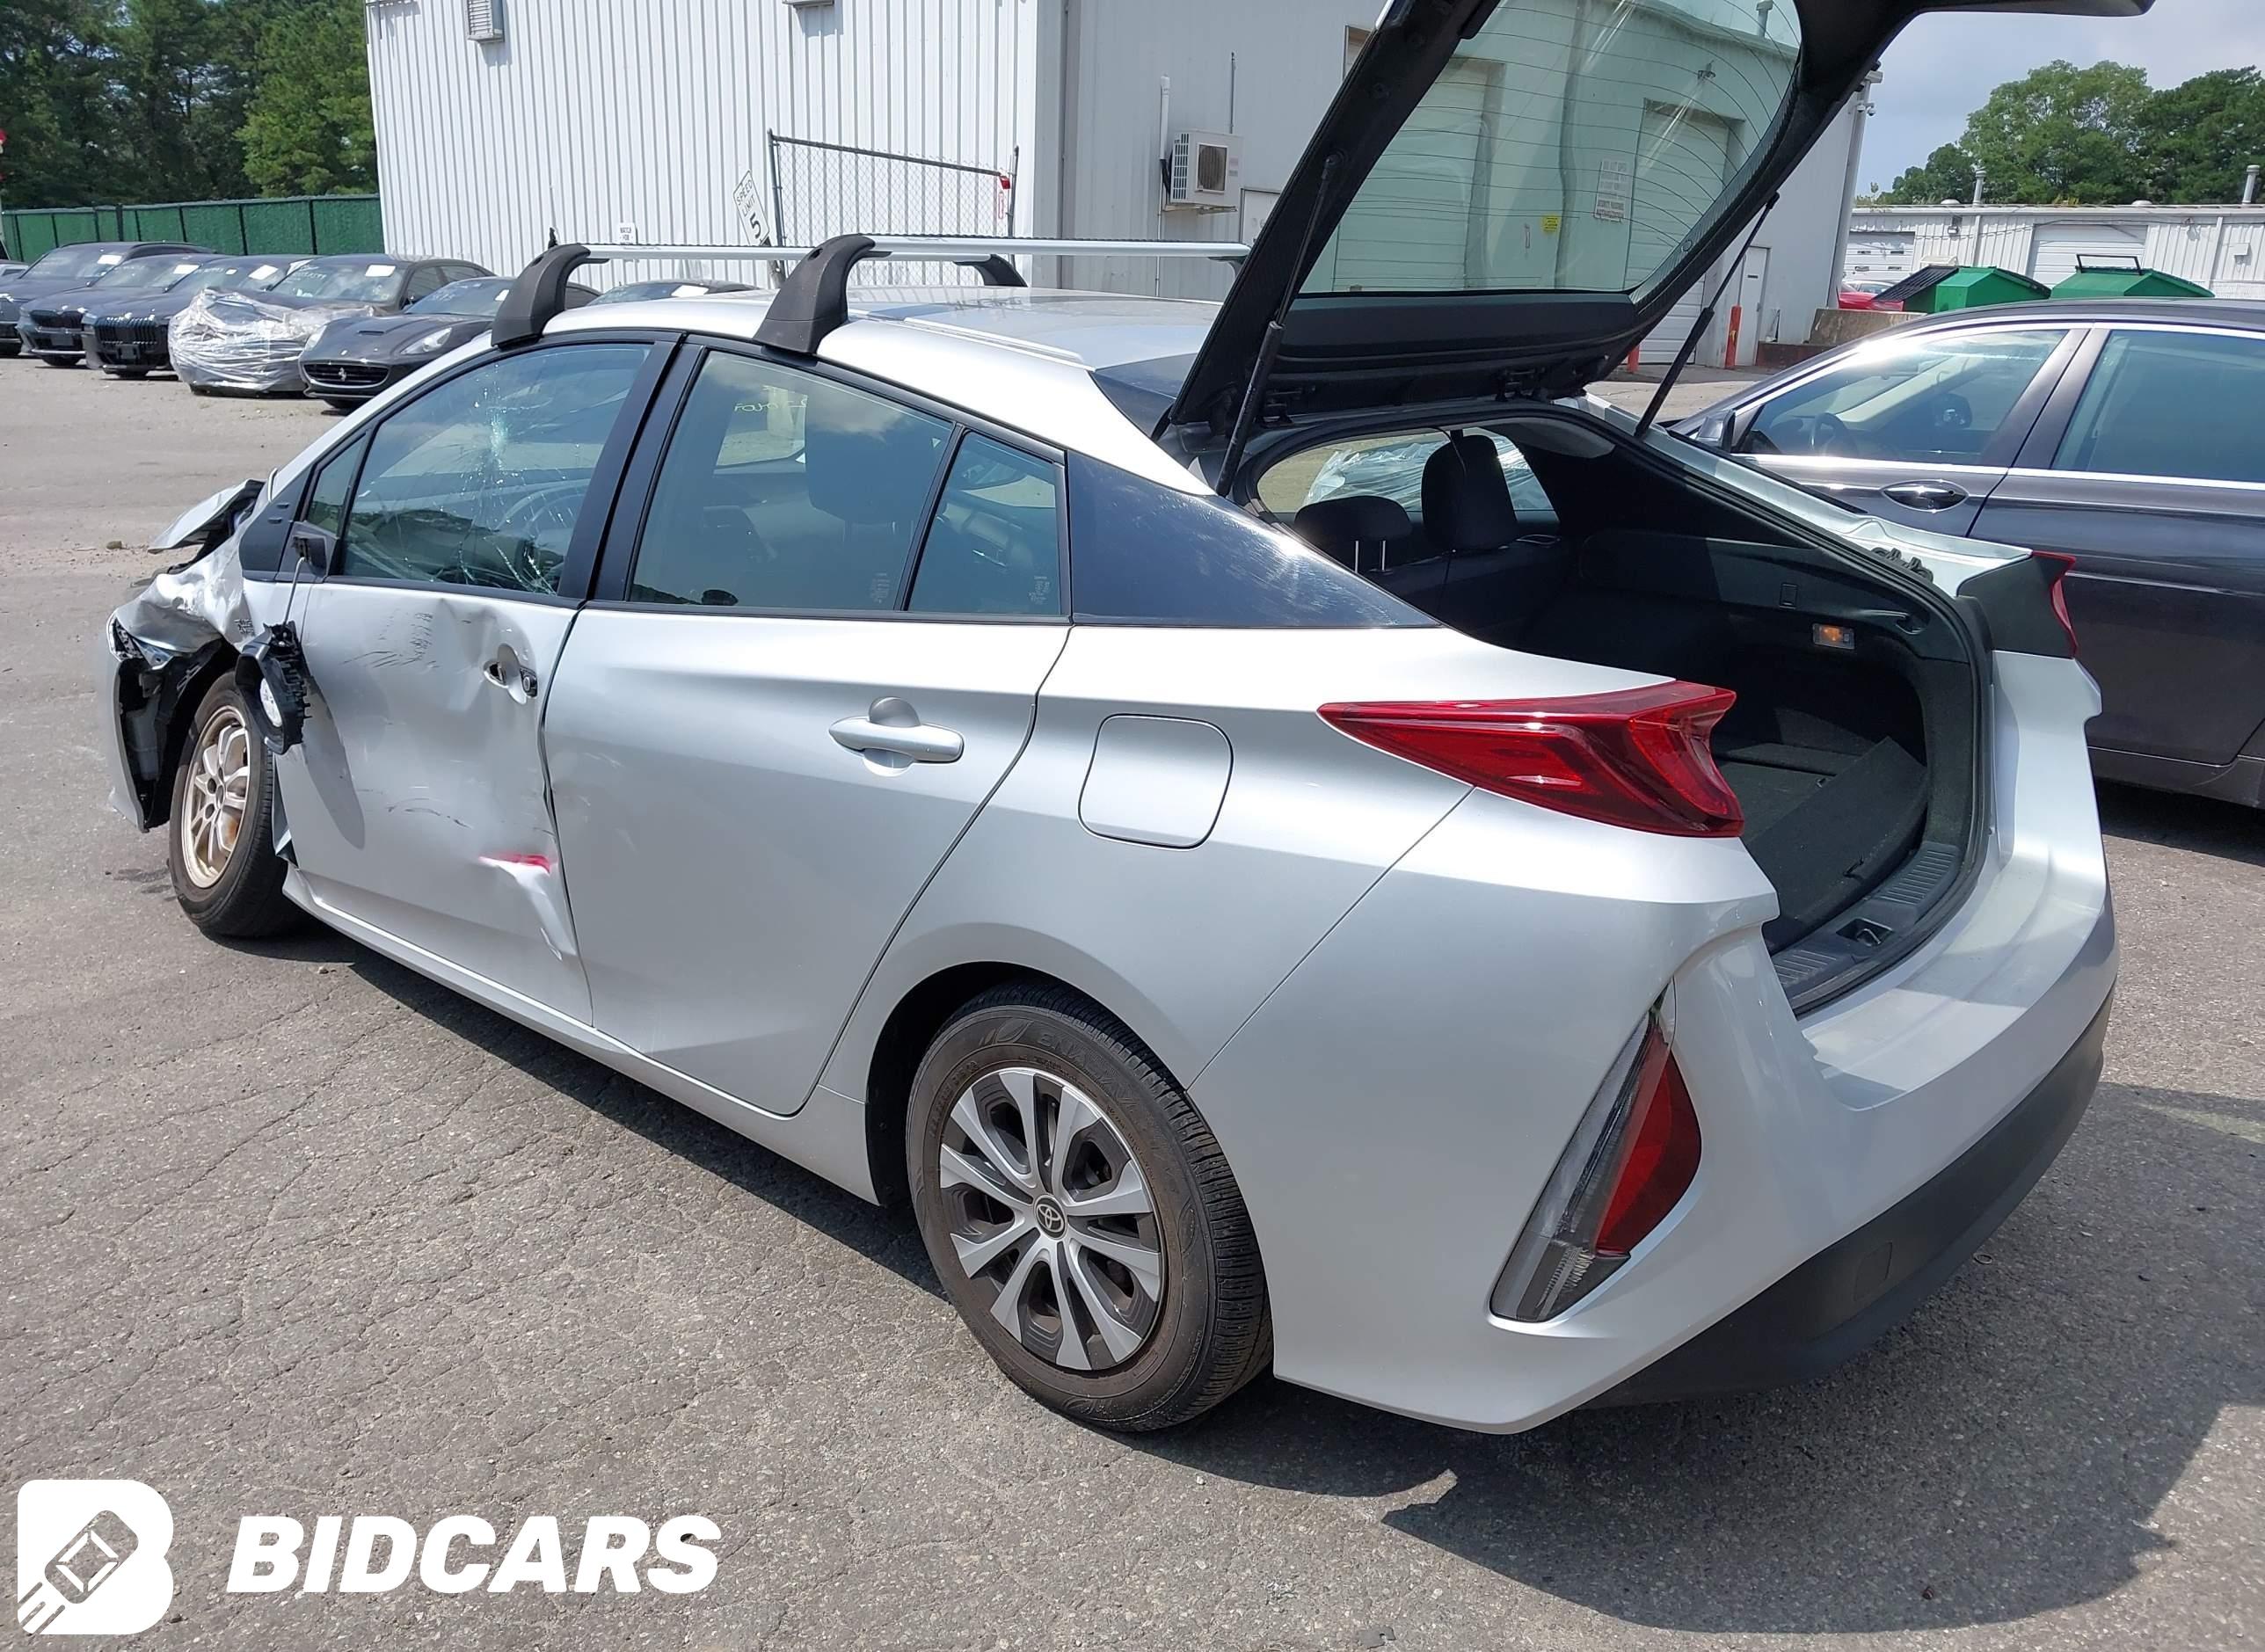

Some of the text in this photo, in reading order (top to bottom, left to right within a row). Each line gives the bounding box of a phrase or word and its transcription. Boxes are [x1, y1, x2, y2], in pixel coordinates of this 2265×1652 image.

[736, 179, 753, 206] SPEED
[741, 194, 756, 217] LIMIT
[749, 212, 761, 239] 5
